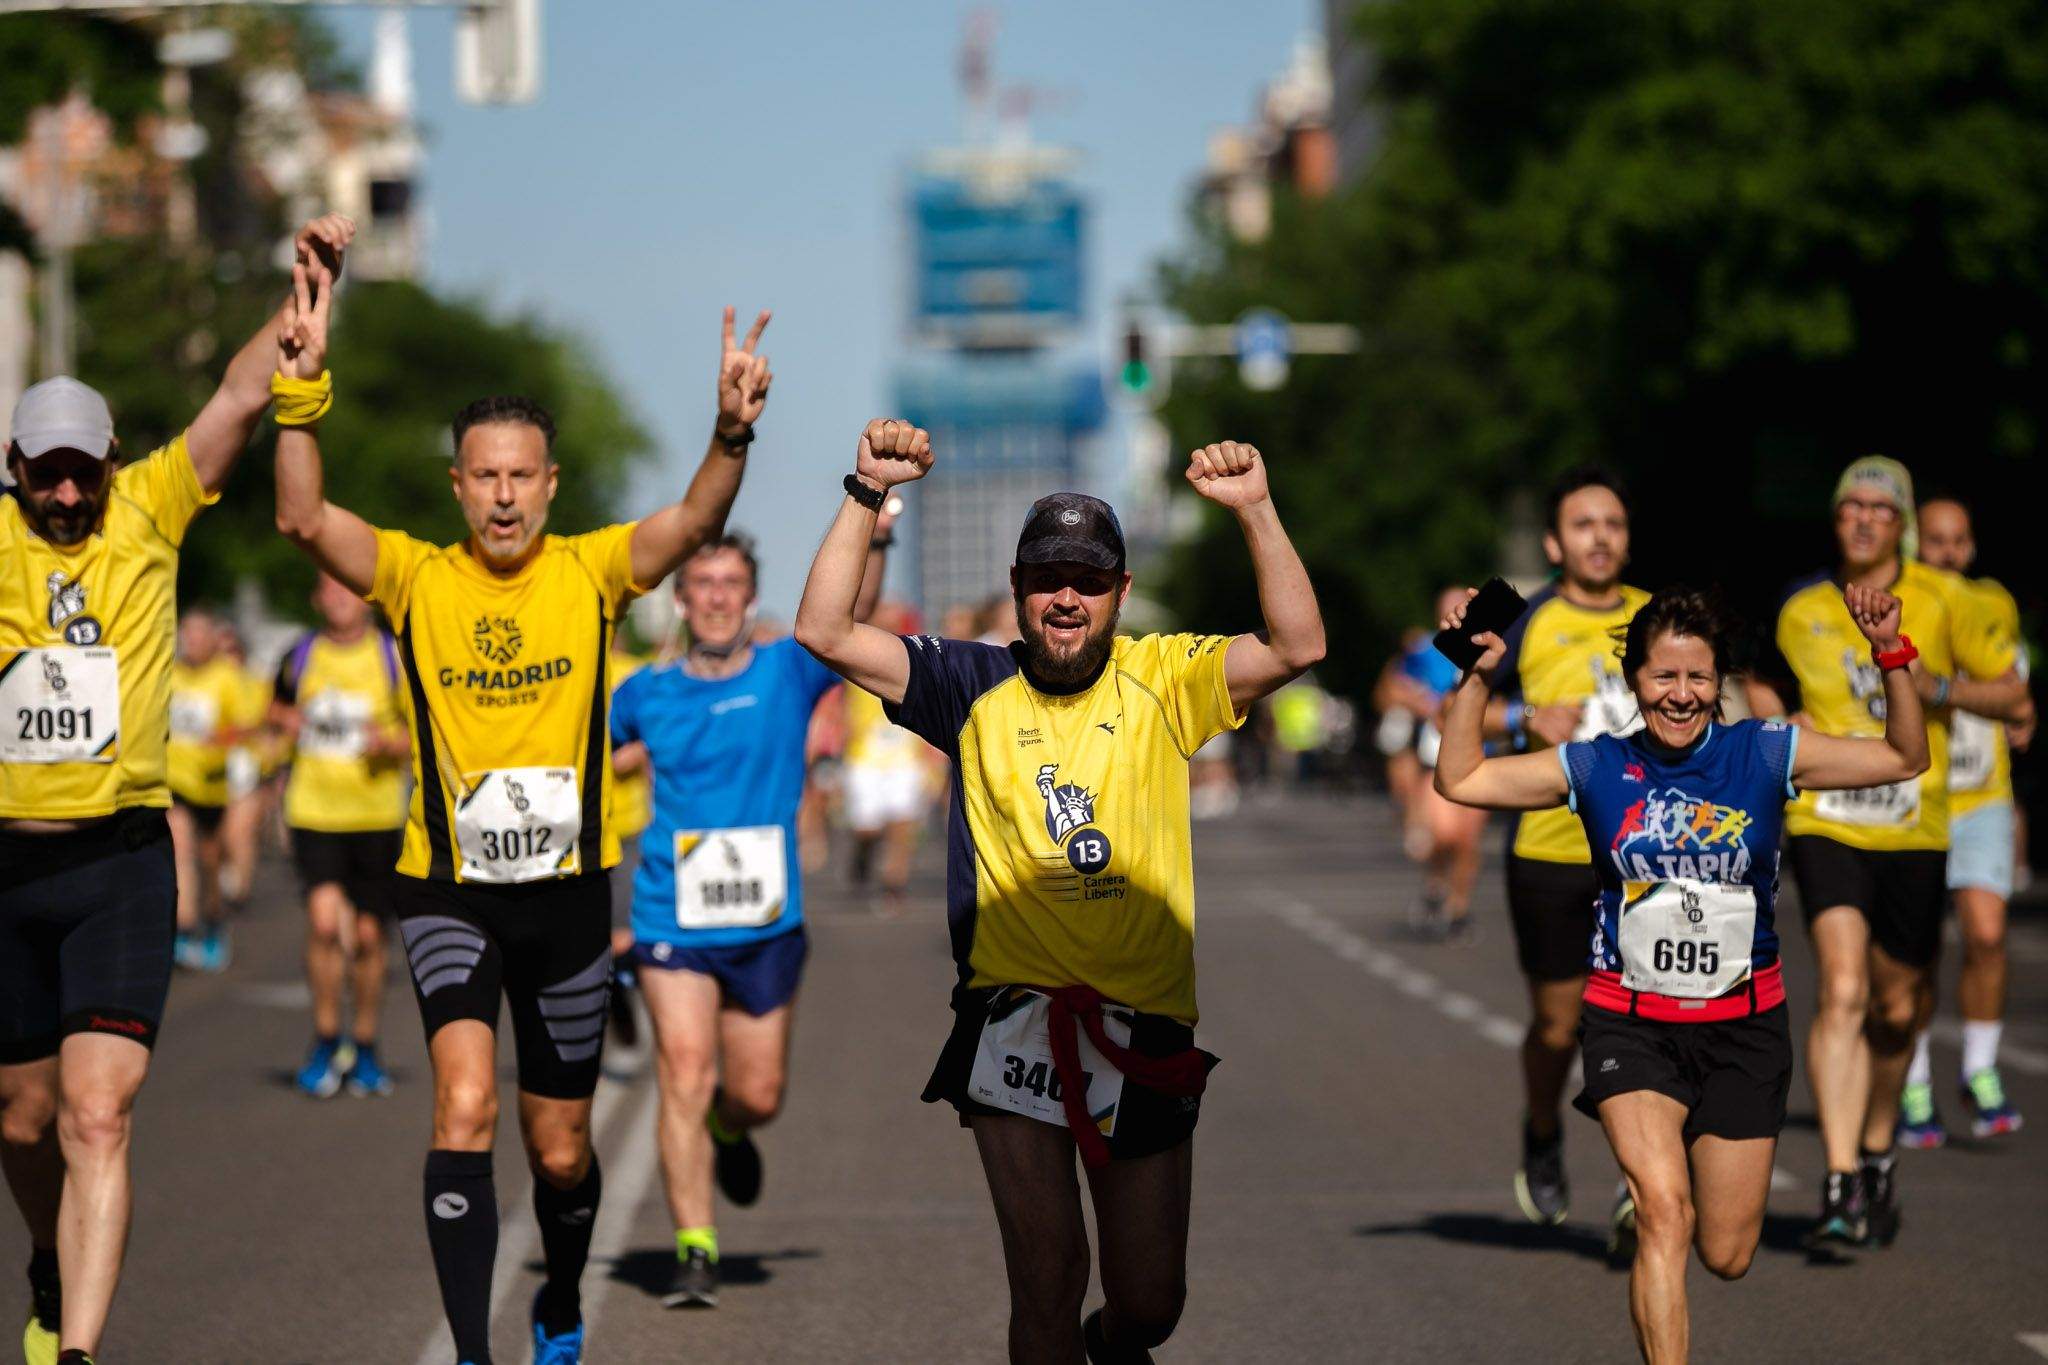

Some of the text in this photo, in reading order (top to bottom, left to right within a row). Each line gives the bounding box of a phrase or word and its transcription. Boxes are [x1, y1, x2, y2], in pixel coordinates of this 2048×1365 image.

[70, 622, 97, 644] 13
[475, 690, 539, 707] SPORTS
[18, 707, 93, 741] 2091
[482, 826, 552, 861] 3012
[1075, 839, 1103, 864] 13
[1083, 875, 1126, 888] Carrera
[1084, 887, 1126, 900] Liberty
[1653, 938, 1720, 976] 695
